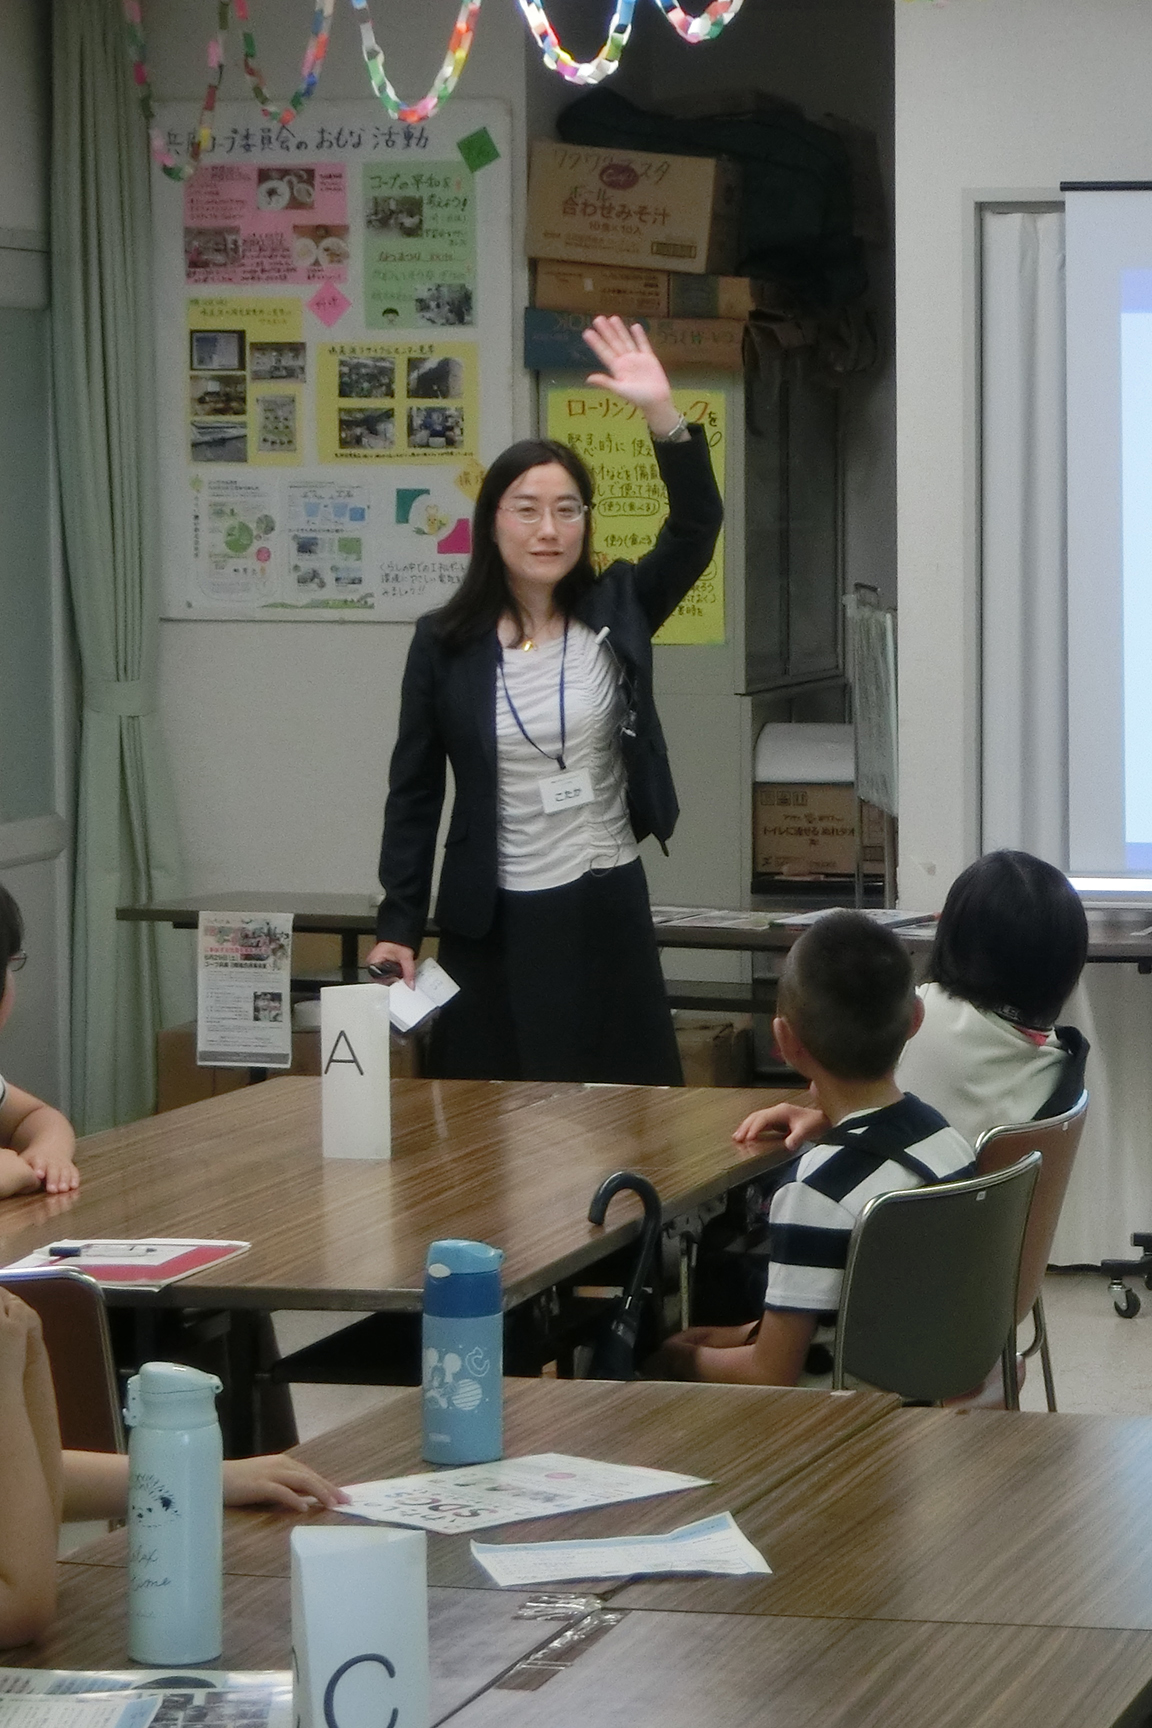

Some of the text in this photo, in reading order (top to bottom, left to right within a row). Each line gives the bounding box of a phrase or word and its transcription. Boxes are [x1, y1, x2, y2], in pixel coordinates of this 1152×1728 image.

[561, 198, 671, 226] 合わせみそ汁
[324, 1029, 364, 1076] A
[323, 1652, 399, 1728] C
